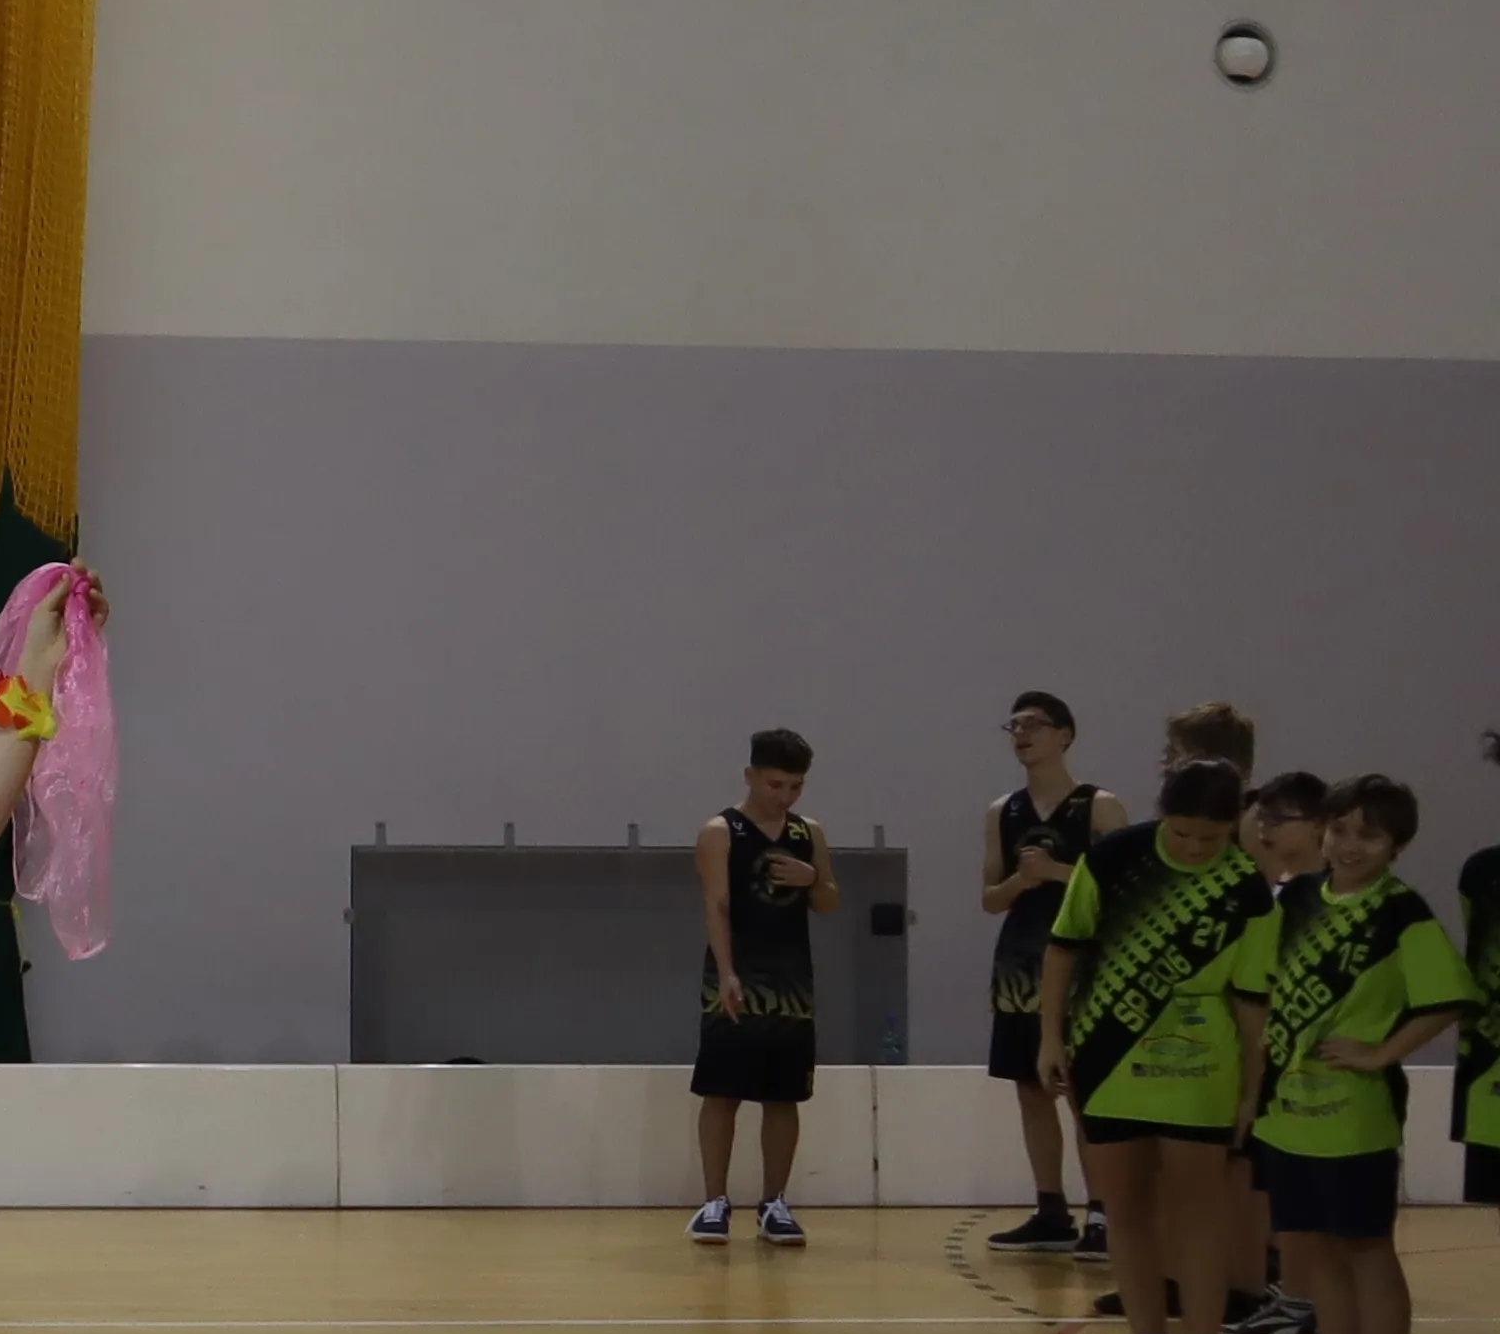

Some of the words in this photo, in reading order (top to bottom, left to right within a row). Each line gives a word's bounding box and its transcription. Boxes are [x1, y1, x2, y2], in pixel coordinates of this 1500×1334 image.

[1192, 916, 1228, 952] 21
[1112, 988, 1151, 1033] SP
[1137, 944, 1192, 1000] 206
